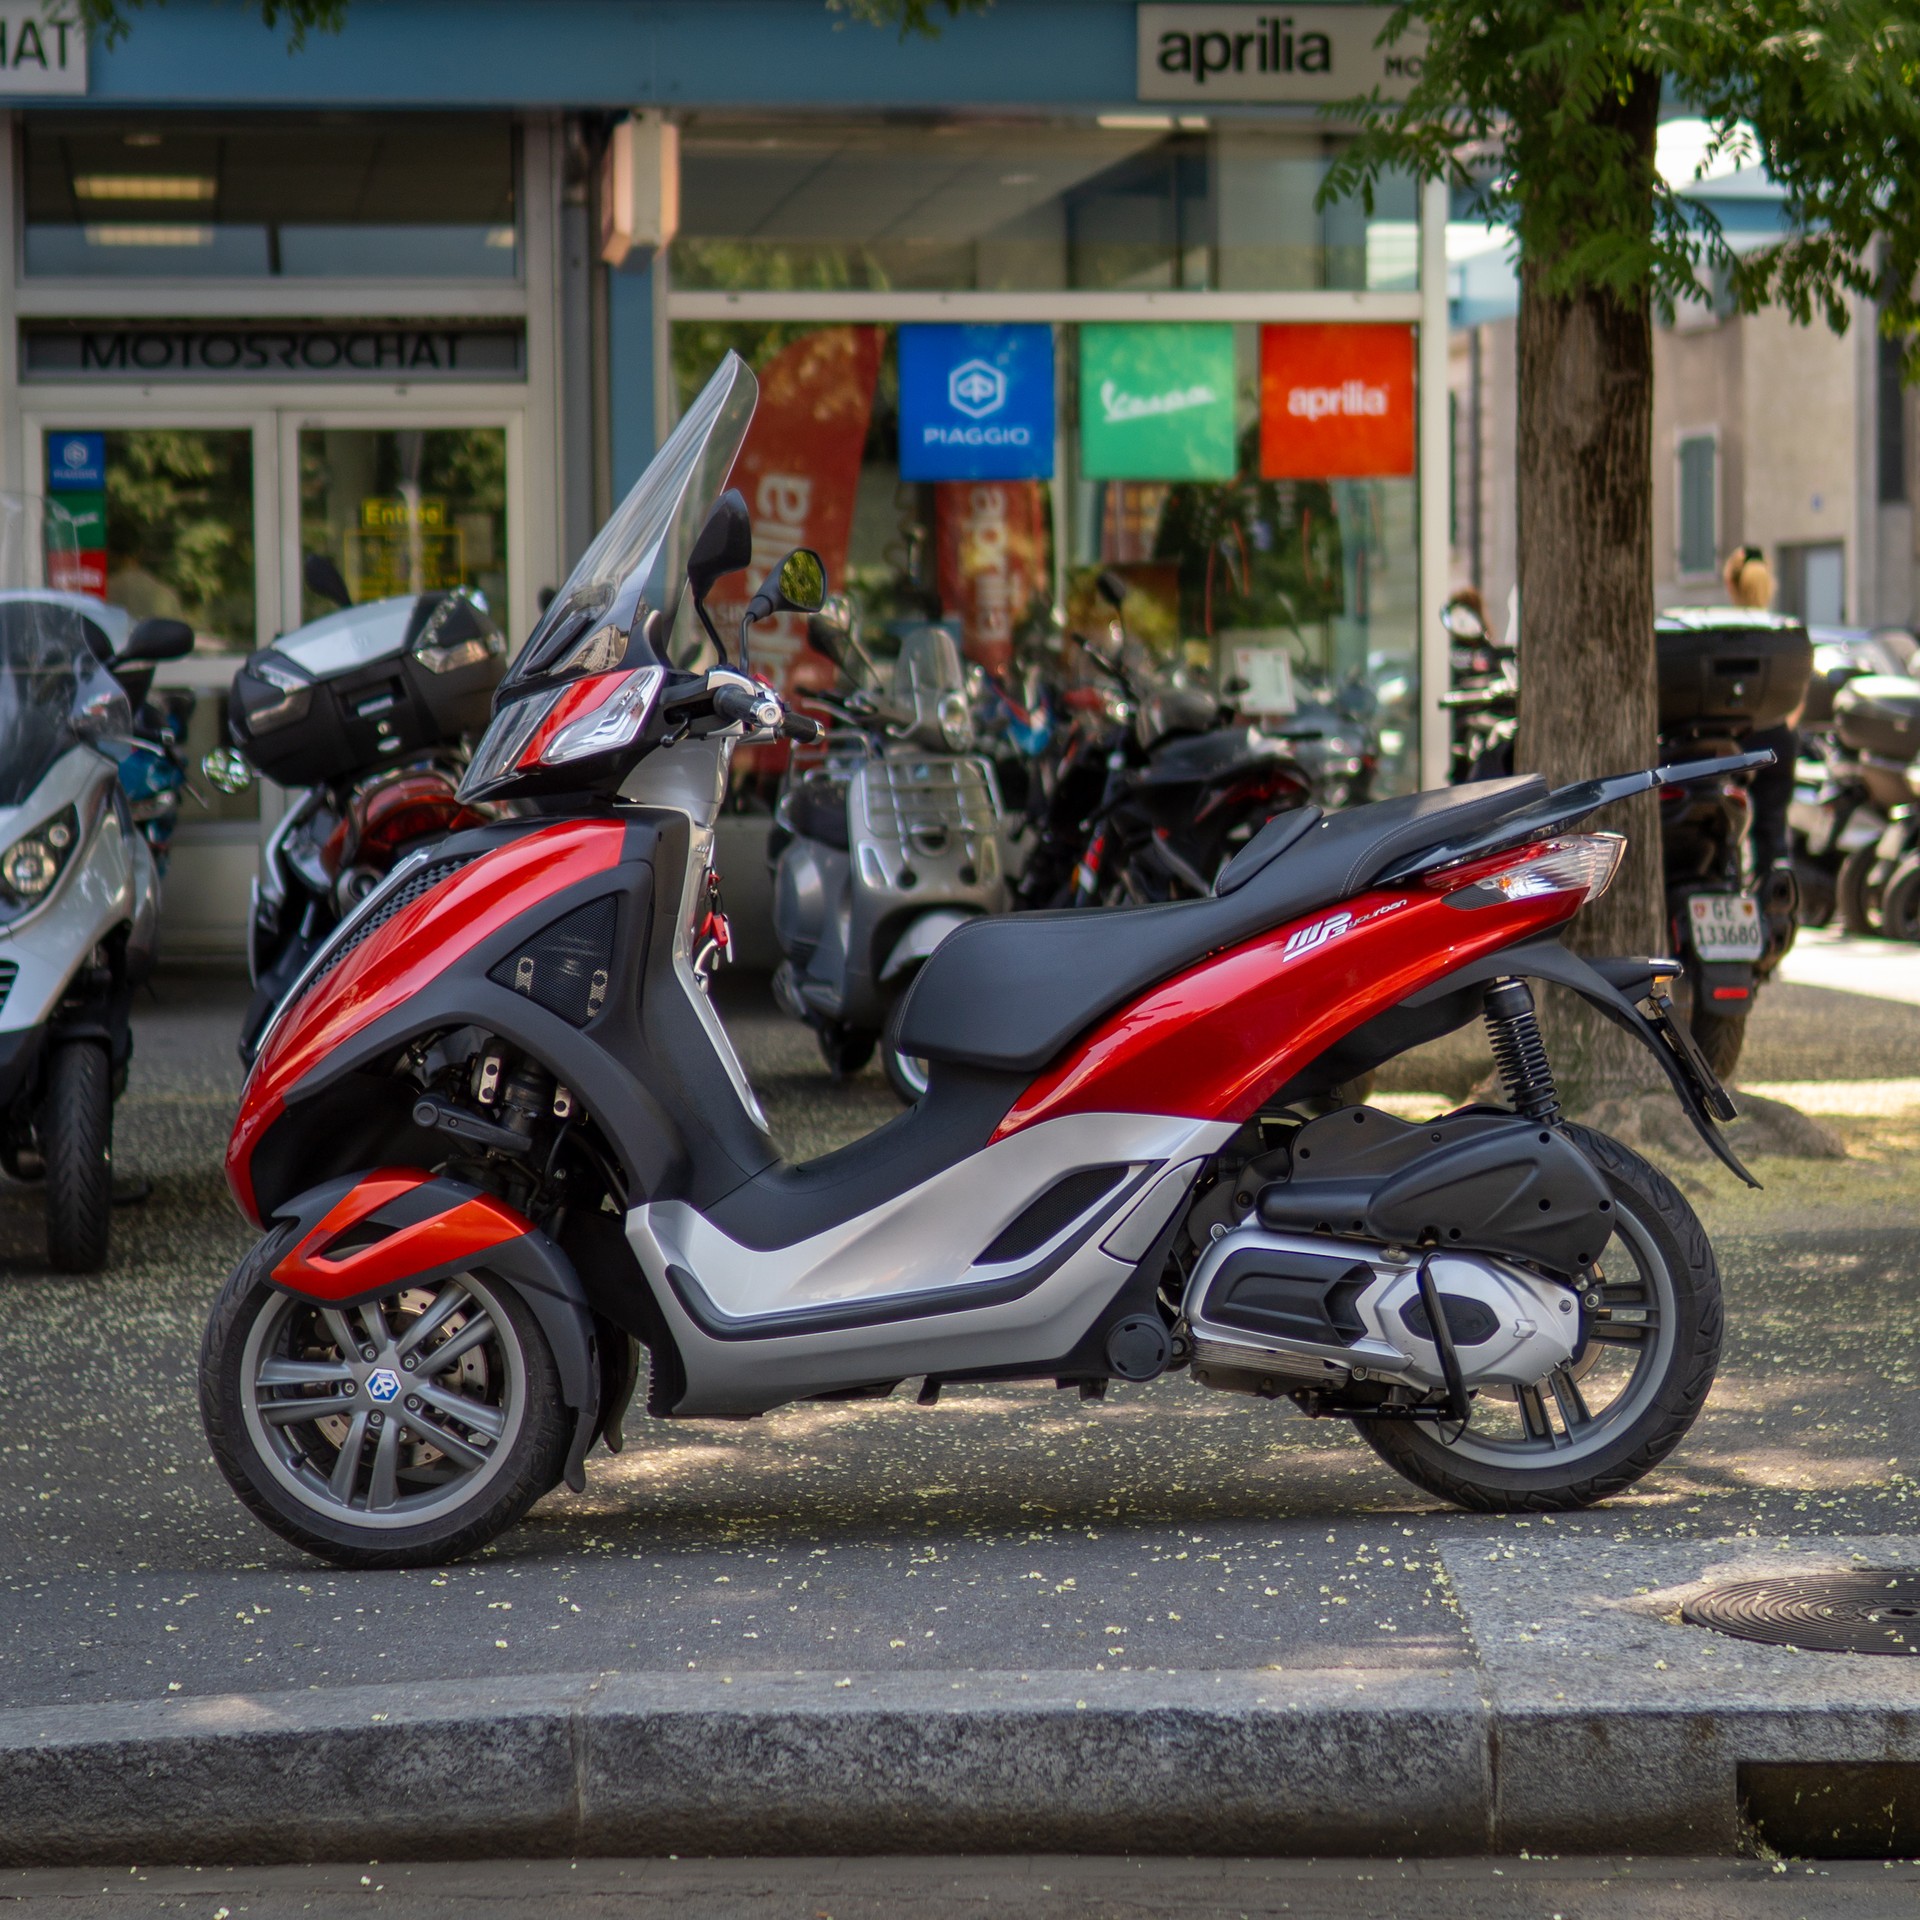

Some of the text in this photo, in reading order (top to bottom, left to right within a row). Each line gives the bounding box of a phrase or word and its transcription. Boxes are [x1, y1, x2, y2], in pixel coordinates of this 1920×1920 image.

[1159, 17, 1331, 83] aprilia
[1288, 380, 1387, 421] aprilia
[924, 427, 1029, 445] PIAGGIO
[366, 500, 439, 525] Ente
[1348, 899, 1407, 929] yourban
[1712, 899, 1735, 921] GE
